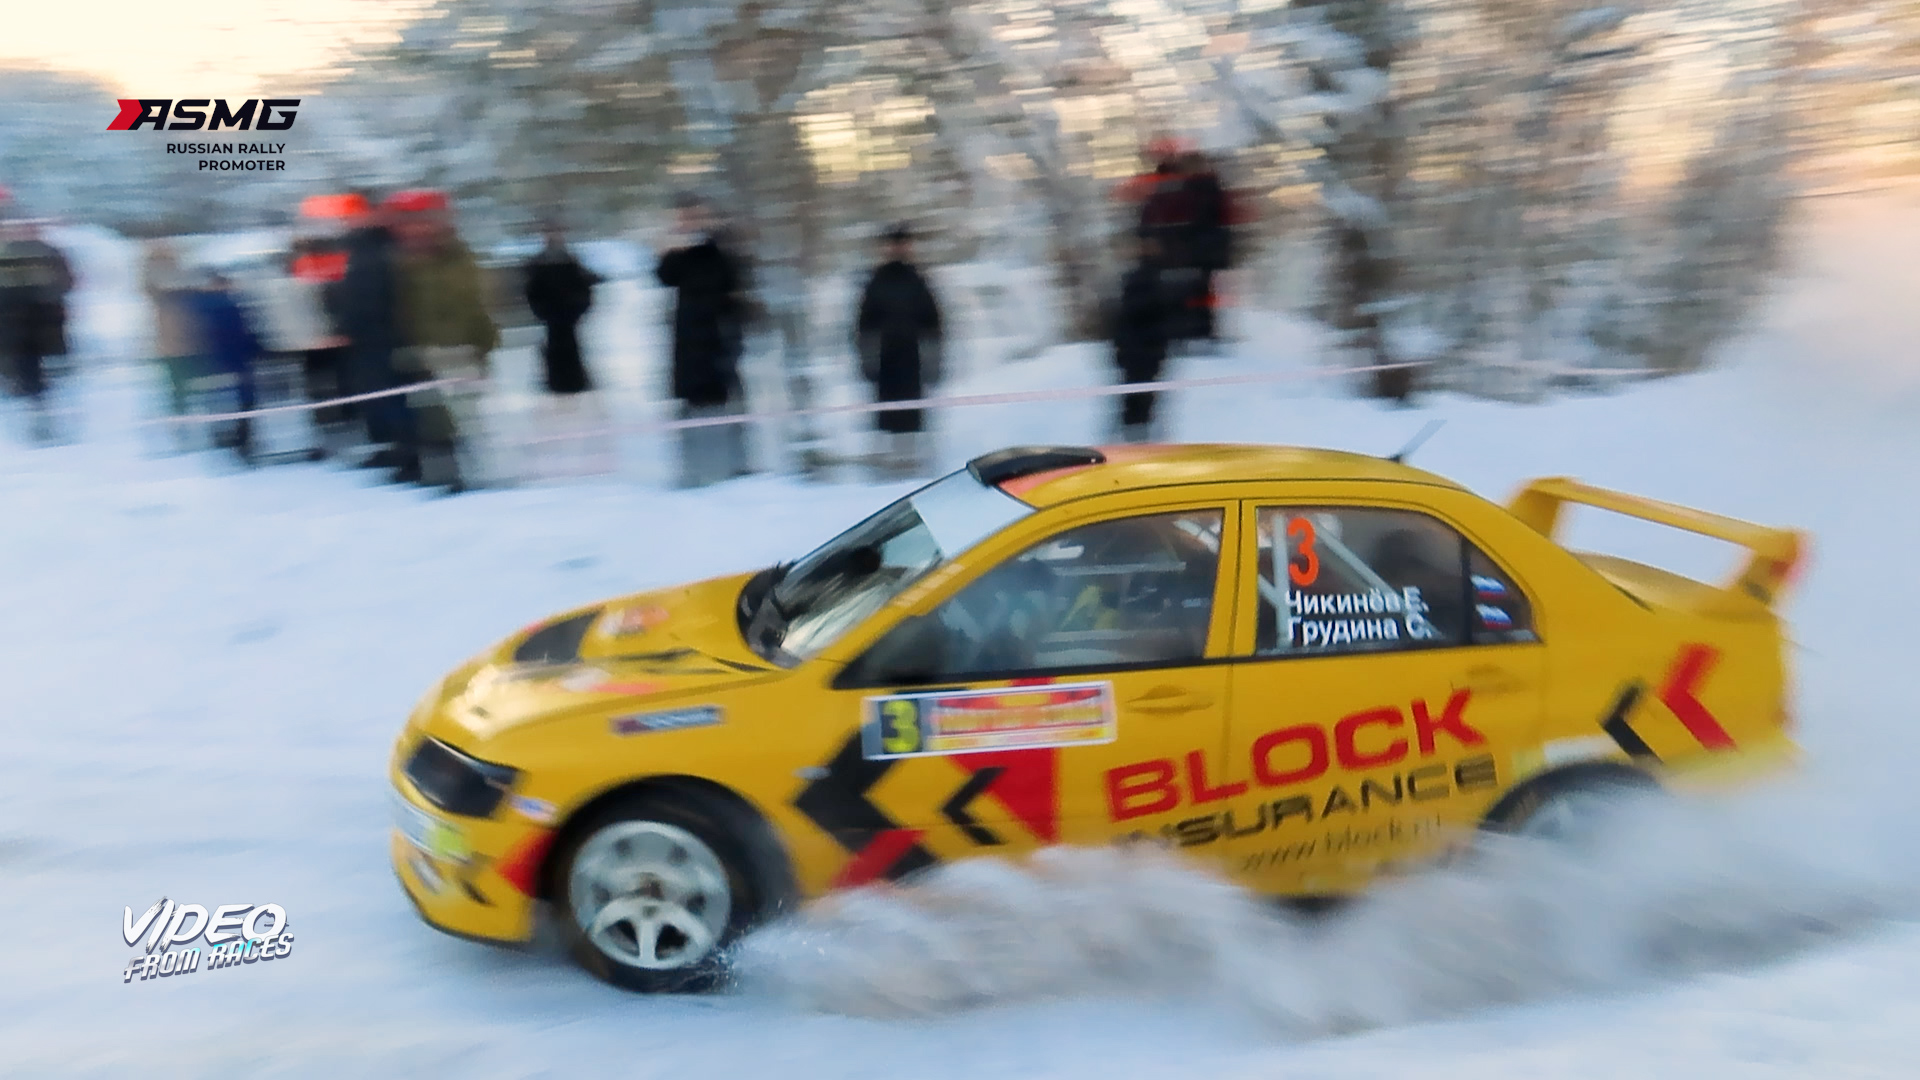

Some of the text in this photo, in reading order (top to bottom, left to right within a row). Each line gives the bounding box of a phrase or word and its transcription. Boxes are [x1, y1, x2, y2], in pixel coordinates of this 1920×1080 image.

[1287, 516, 1320, 586] 3
[1285, 587, 1400, 615] Чикинёв
[1287, 615, 1399, 646] Грудина
[882, 699, 921, 754] 3
[1104, 688, 1488, 823] BLOCK
[1108, 753, 1498, 850] SURANCE
